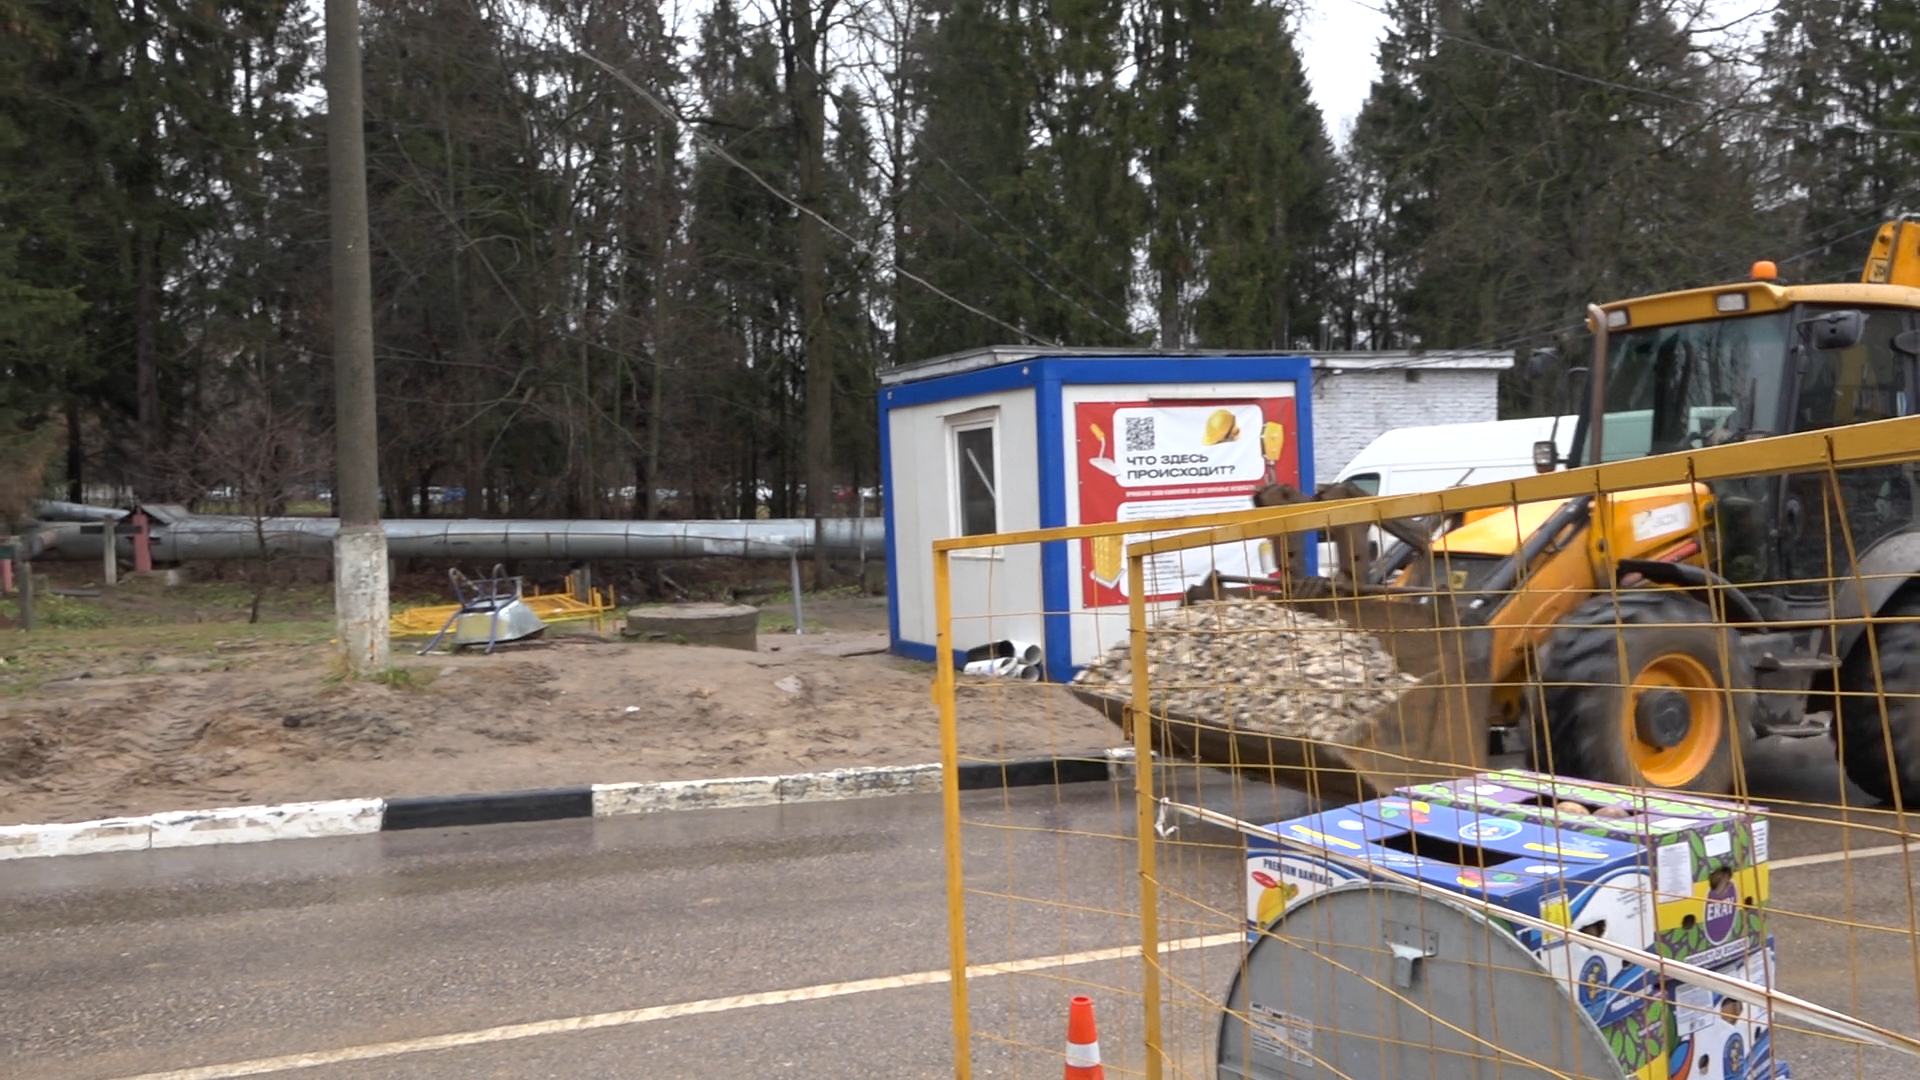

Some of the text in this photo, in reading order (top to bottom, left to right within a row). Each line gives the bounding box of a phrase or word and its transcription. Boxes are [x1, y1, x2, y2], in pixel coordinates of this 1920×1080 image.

[1126, 454, 1209, 466] ЧТО ЗДЕСЬ
[1127, 465, 1236, 480] ПРОИСХОДИТ?
[1263, 858, 1297, 877] PREMIUM
